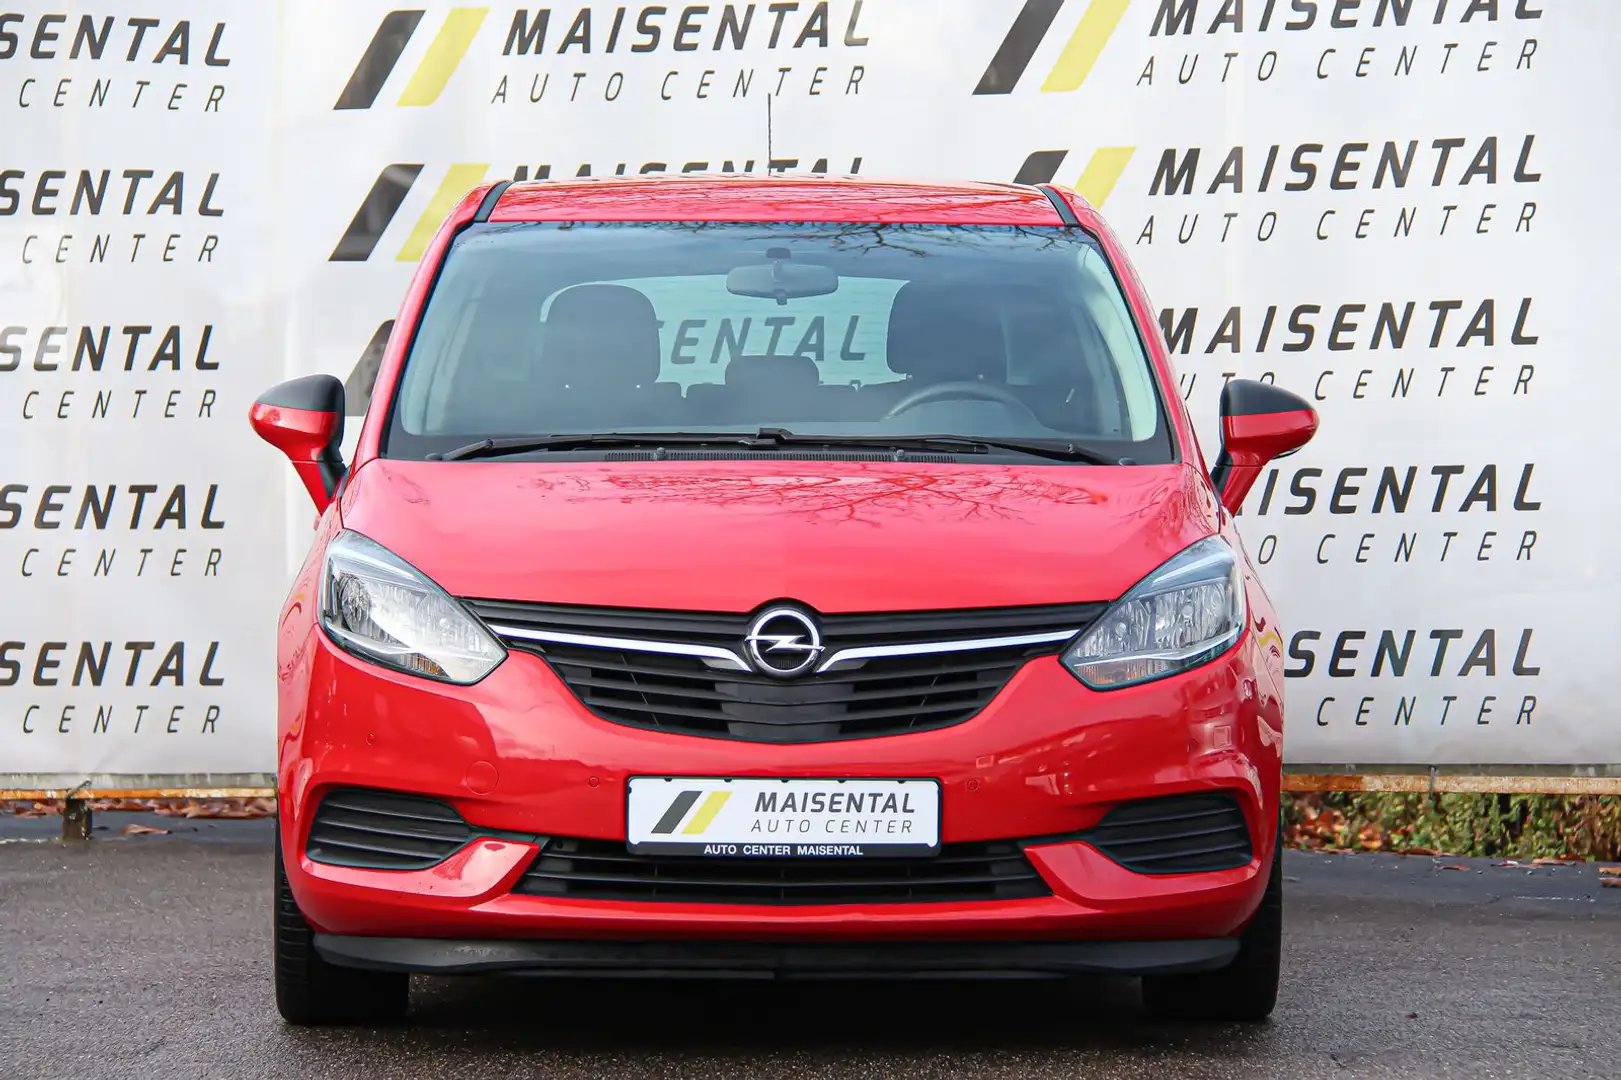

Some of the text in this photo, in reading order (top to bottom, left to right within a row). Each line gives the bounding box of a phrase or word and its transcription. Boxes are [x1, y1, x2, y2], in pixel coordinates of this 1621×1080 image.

[503, 0, 868, 55] MAISENTAL
[1137, 38, 1538, 86] AUTO CENTER
[18, 78, 225, 112] CENTER
[492, 65, 865, 104] AUTO CENTER
[1148, 134, 1542, 196] MAISENTAL
[1136, 201, 1537, 245] AUTO CENTER
[22, 233, 219, 264] CENTER
[657, 315, 866, 365] ENTAL
[1158, 298, 1539, 354] MAISENTAL
[1314, 364, 1535, 401] CENTER
[22, 389, 217, 420] CENTER
[1236, 463, 1542, 516] ISENTAL
[21, 547, 222, 578] CENTER
[1316, 530, 1538, 565] CENTER
[22, 704, 220, 734] CENTER
[1316, 695, 1538, 727] CENTER
[754, 791, 915, 814] MAISENTAL
[751, 819, 912, 834] AUTO CENTER
[704, 844, 863, 857] AUTO CENTER MAISENTAL
